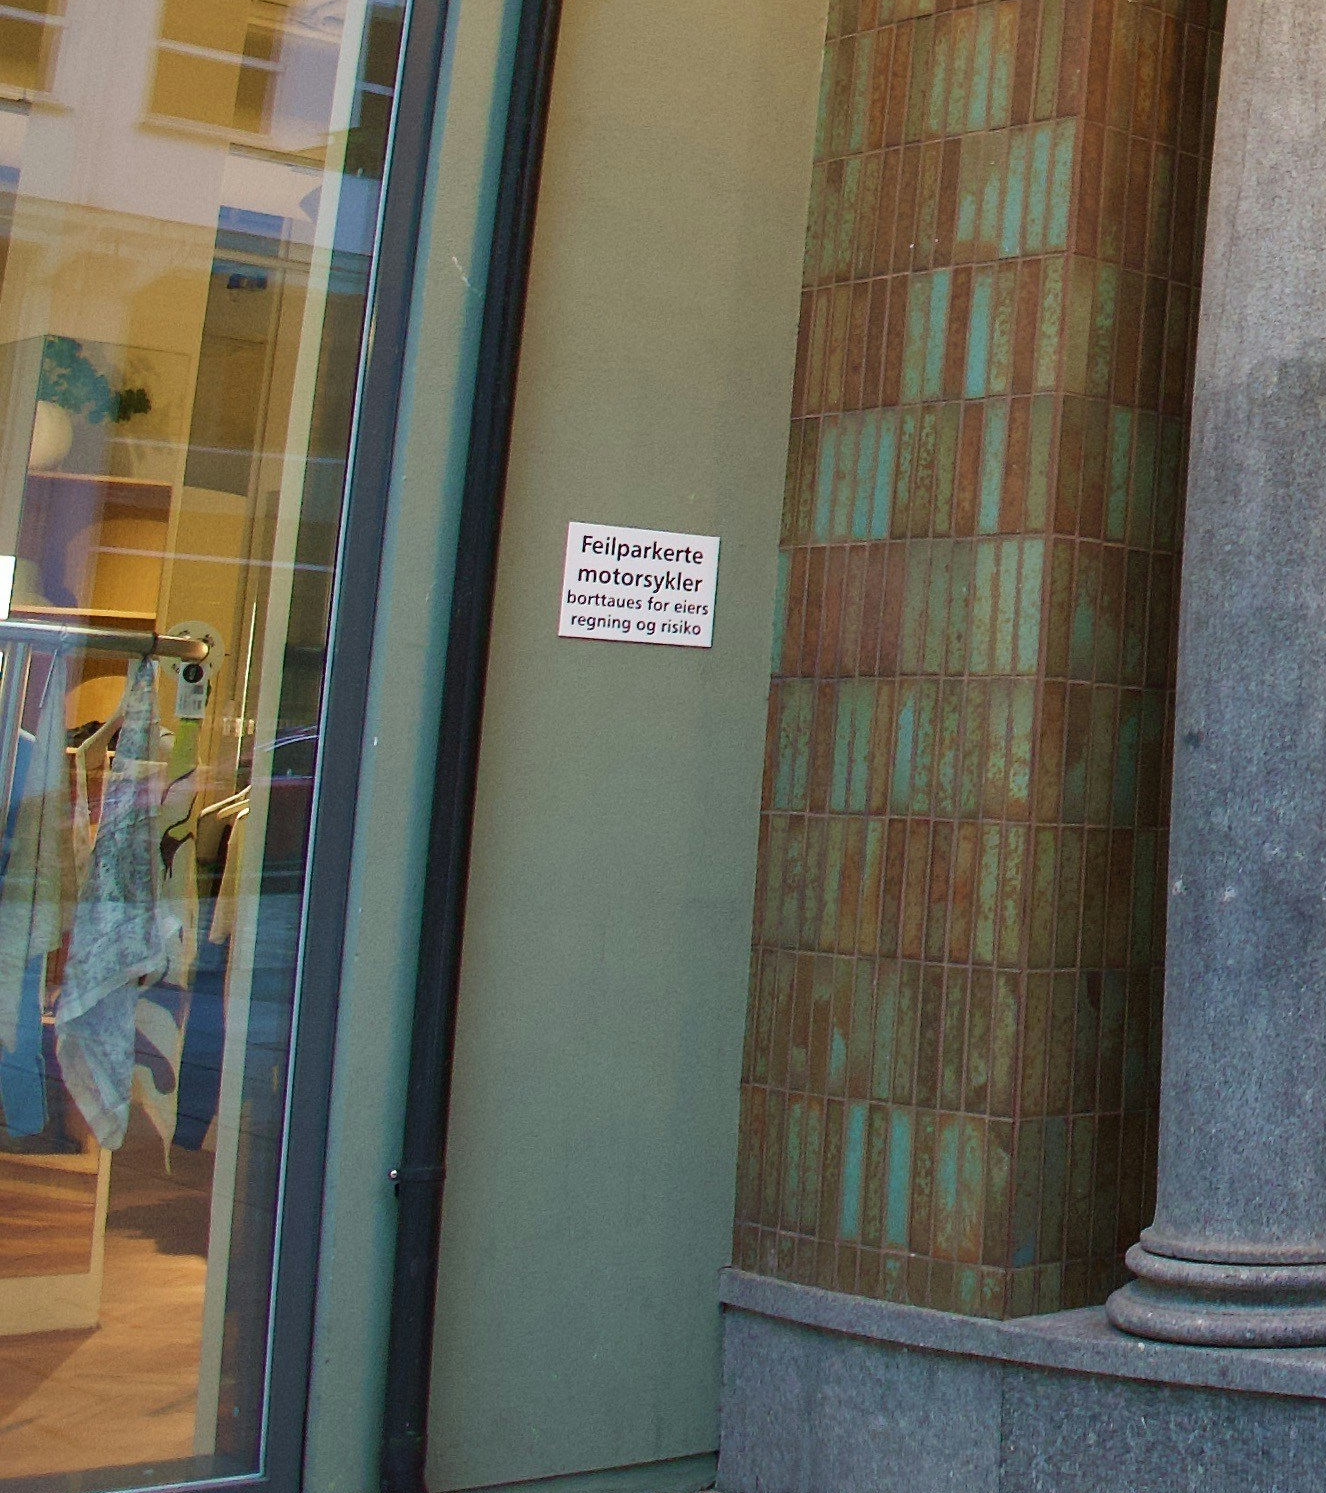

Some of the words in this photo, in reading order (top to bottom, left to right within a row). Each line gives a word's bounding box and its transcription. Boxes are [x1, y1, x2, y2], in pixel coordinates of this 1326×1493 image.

[581, 534, 704, 565] Feilparkerte
[577, 567, 704, 594] motorsykler
[566, 589, 642, 610] borttaues
[647, 596, 670, 613] for
[674, 599, 709, 616] eiers
[571, 613, 631, 634] regning
[636, 620, 656, 635] og
[661, 619, 701, 636] risiko
